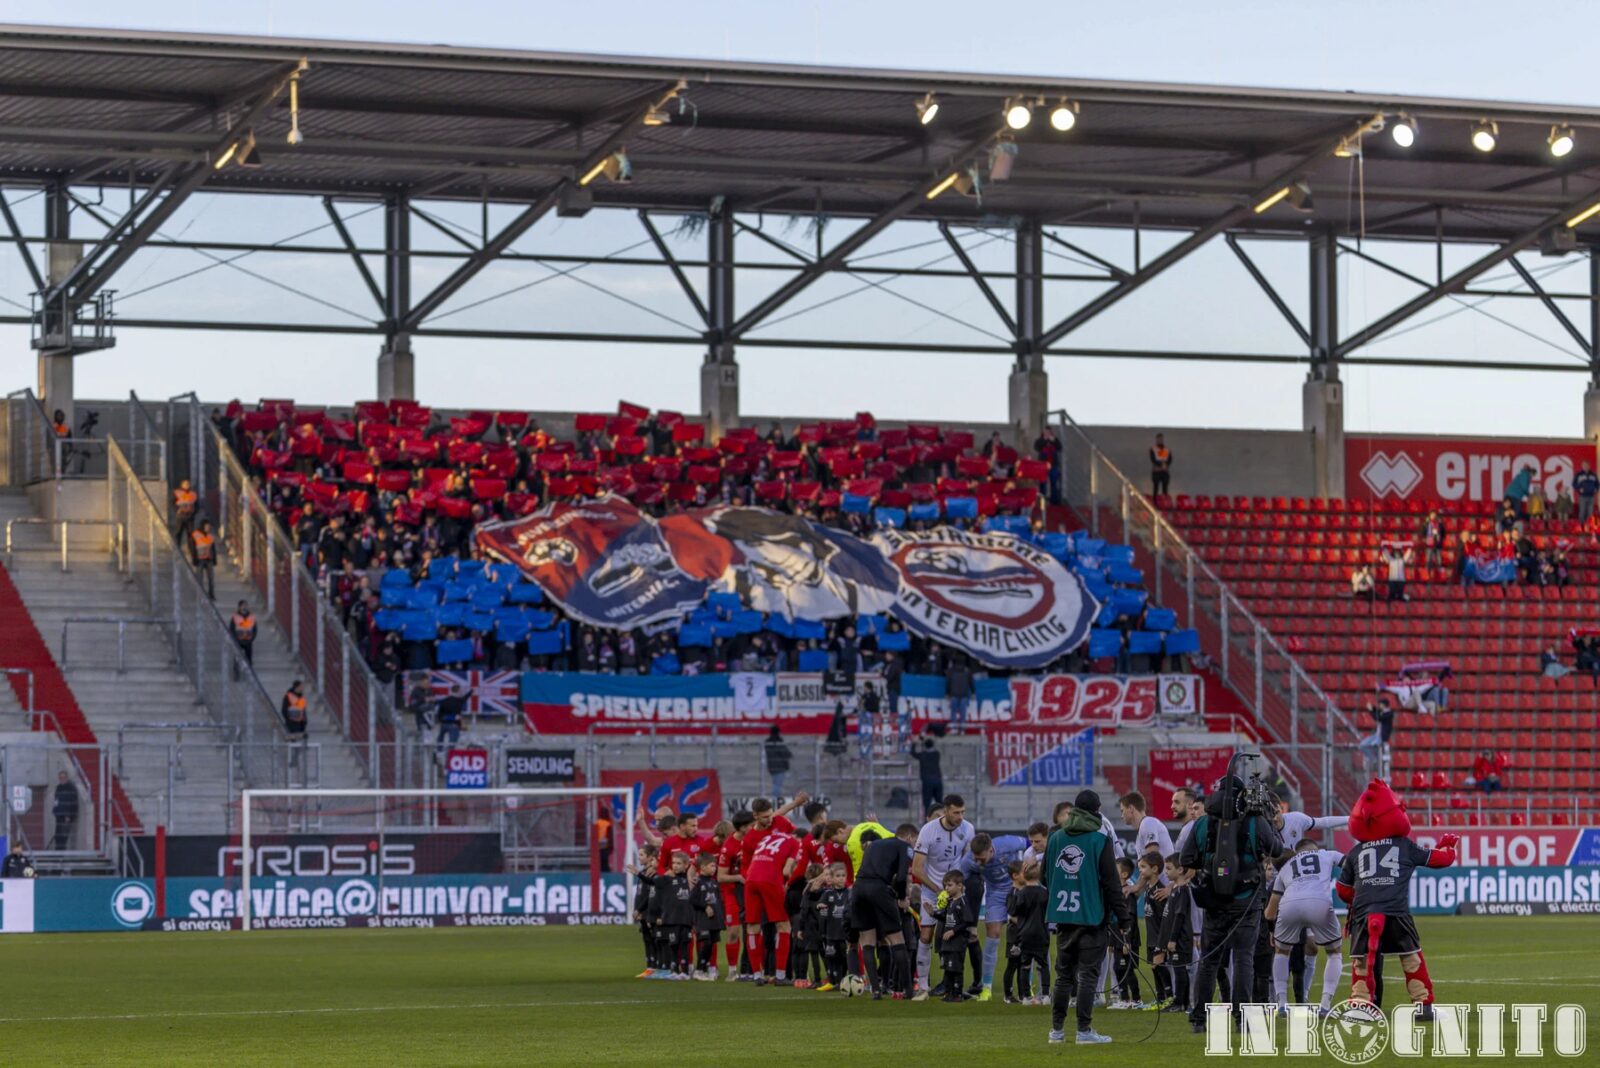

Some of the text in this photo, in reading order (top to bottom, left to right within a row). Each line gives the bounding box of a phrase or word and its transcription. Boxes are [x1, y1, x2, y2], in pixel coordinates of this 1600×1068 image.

[724, 369, 735, 382] H
[901, 588, 1067, 652] NTERHACHING
[1010, 674, 1157, 726] 1925
[450, 755, 485, 771] OLD
[507, 757, 573, 775] SENDLING
[998, 759, 1023, 782] ON
[448, 772, 485, 786] BOYS
[754, 836, 786, 855] 34
[1362, 838, 1393, 849] SCHANZI
[1416, 836, 1556, 867] LHOF
[1290, 854, 1321, 879] 19
[1358, 846, 1400, 879] 04
[189, 877, 637, 918] service@gunvor-deuts
[1056, 890, 1080, 912] 25
[1489, 903, 1532, 915] energy
[179, 919, 231, 932] energy
[269, 915, 346, 928] electronics
[383, 916, 434, 928] energy
[470, 914, 546, 926] electronics
[582, 914, 628, 925] energ
